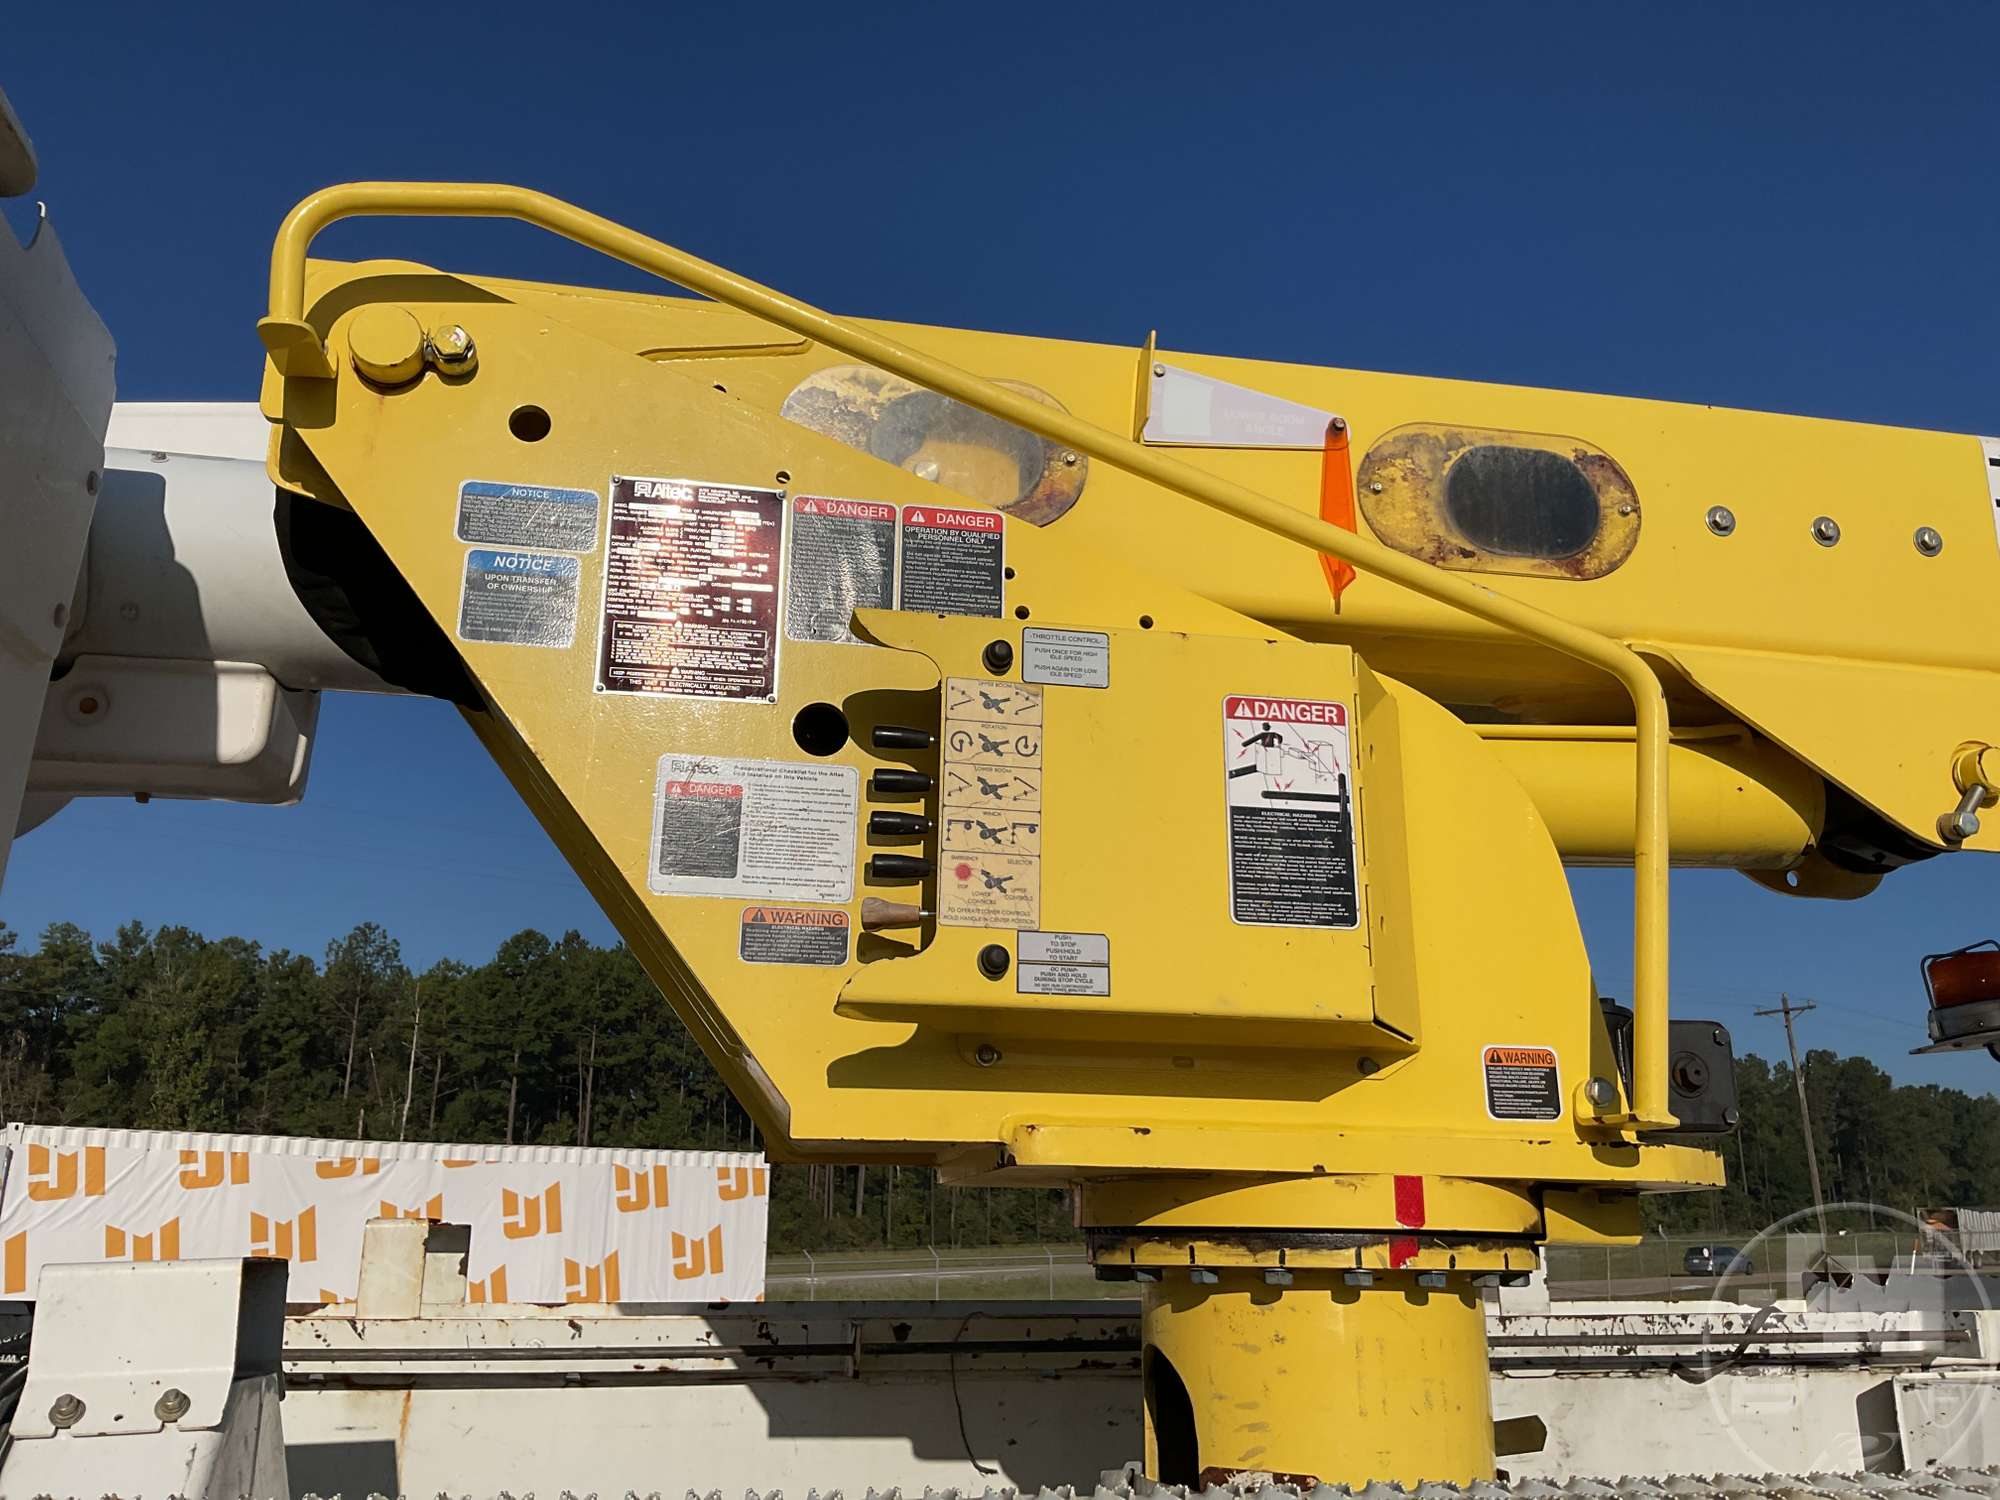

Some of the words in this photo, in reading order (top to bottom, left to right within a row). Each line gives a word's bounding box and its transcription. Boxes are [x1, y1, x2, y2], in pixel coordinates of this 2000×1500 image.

[511, 487, 551, 499] NOTICE
[826, 502, 888, 518] DANGER
[936, 513, 995, 528] DANGER
[905, 526, 948, 536] OPERATION
[961, 531, 1000, 540] QUALIFIED
[918, 533, 963, 544] PERSONNEL
[494, 556, 555, 571] NOTICE
[485, 574, 509, 582] UPON
[512, 575, 557, 586] TRANSFER
[487, 582, 499, 590] OF
[501, 583, 554, 593] OWNERSHIP
[1254, 701, 1338, 723] DANGER
[689, 783, 732, 794] DANGER
[770, 911, 843, 925] WARNING
[1503, 1051, 1553, 1065] WARNING
